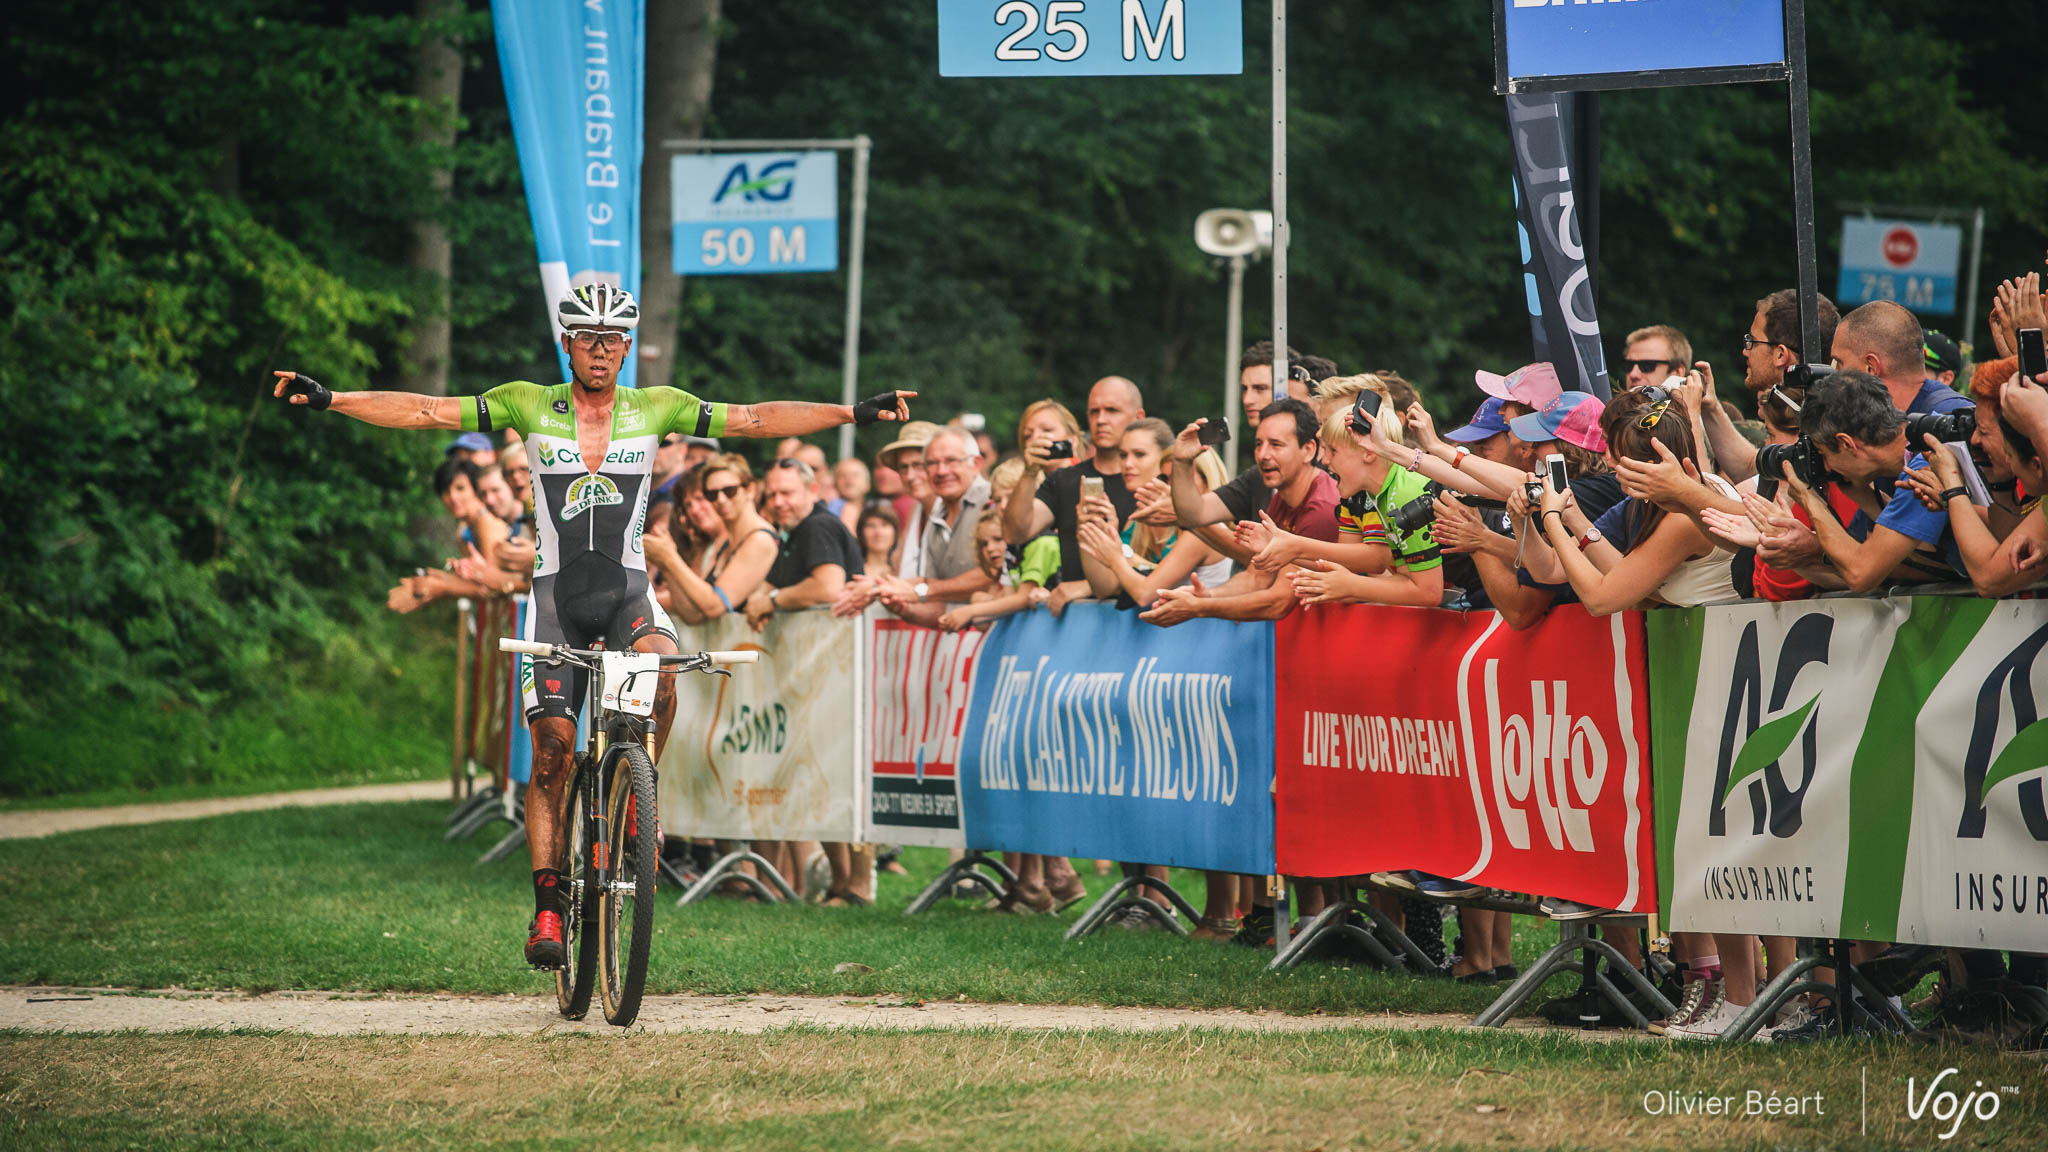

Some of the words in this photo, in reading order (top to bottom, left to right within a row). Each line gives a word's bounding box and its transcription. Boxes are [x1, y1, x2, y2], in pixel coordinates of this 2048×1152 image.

[994, 0, 1089, 62] 25
[1121, 0, 1186, 61] M
[711, 159, 797, 204] AG
[702, 227, 755, 267] 50
[769, 225, 806, 265] M
[1906, 275, 1935, 308] M
[579, 496, 613, 509] DRINK
[583, 483, 607, 499] AA
[980, 655, 1033, 791] HET
[1024, 655, 1125, 797] LAATSTE
[1127, 656, 1239, 807] NIEUWS
[1303, 711, 1341, 769] LIVE
[1341, 713, 1393, 773] YOUR
[1391, 716, 1461, 778] DREAM
[1708, 612, 1836, 839] AG
[1703, 866, 1815, 903] INSURANCE
